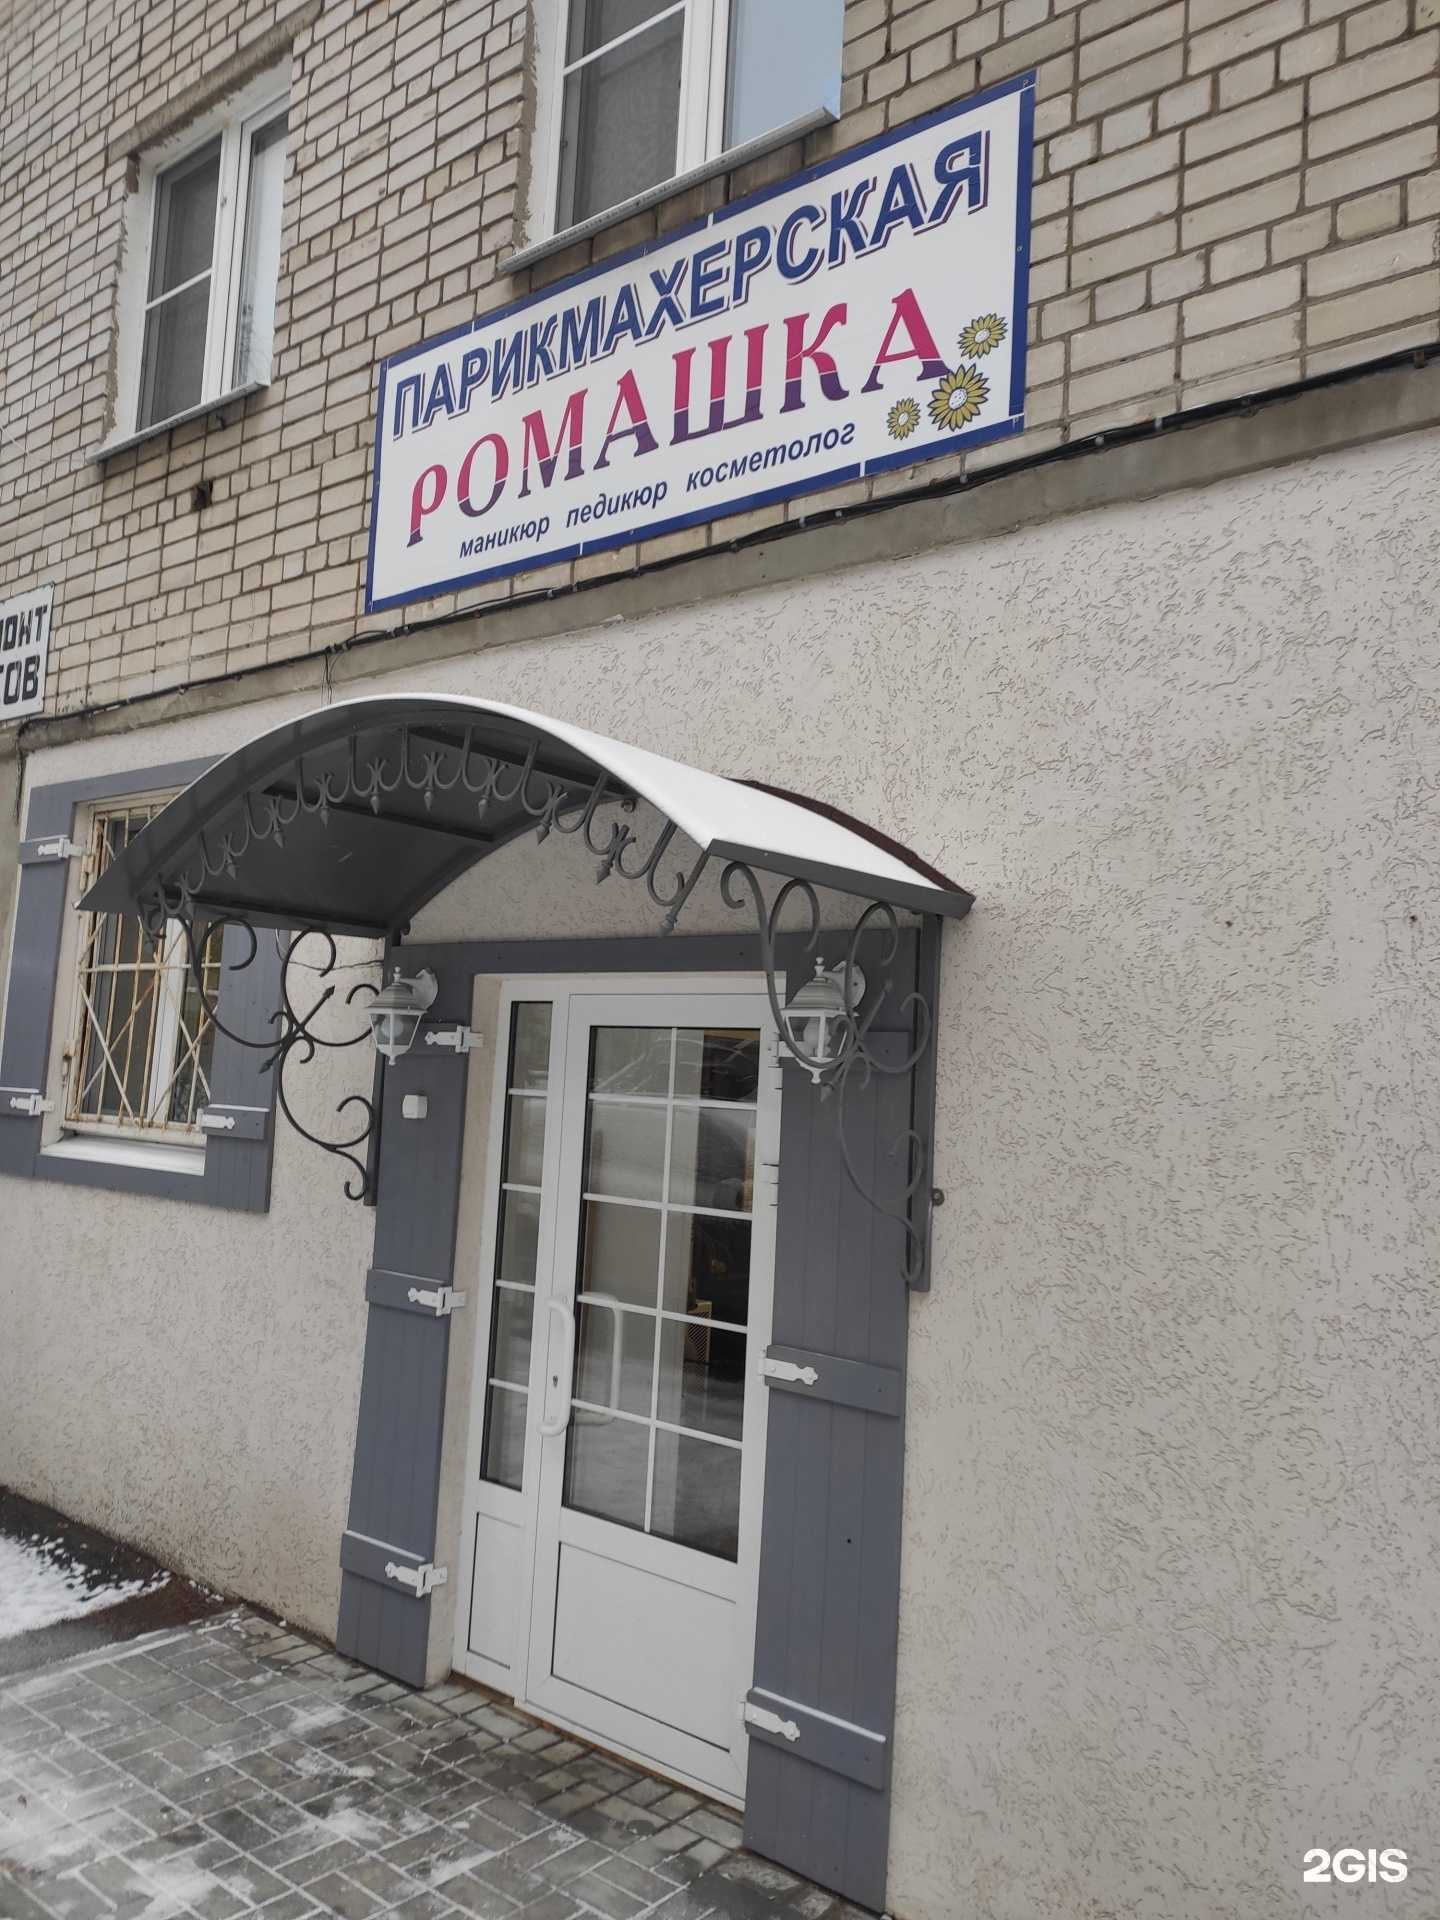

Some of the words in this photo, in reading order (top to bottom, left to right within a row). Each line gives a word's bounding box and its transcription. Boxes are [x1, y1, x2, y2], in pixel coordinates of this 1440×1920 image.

[392, 130, 990, 440] ПАРИКМАХЕРСКАЯ
[407, 288, 949, 547] РОМАШКА
[459, 514, 550, 559] маникюр
[566, 478, 668, 529] педикюр
[685, 421, 856, 492] косметолог
[0, 604, 48, 651] ОНТ
